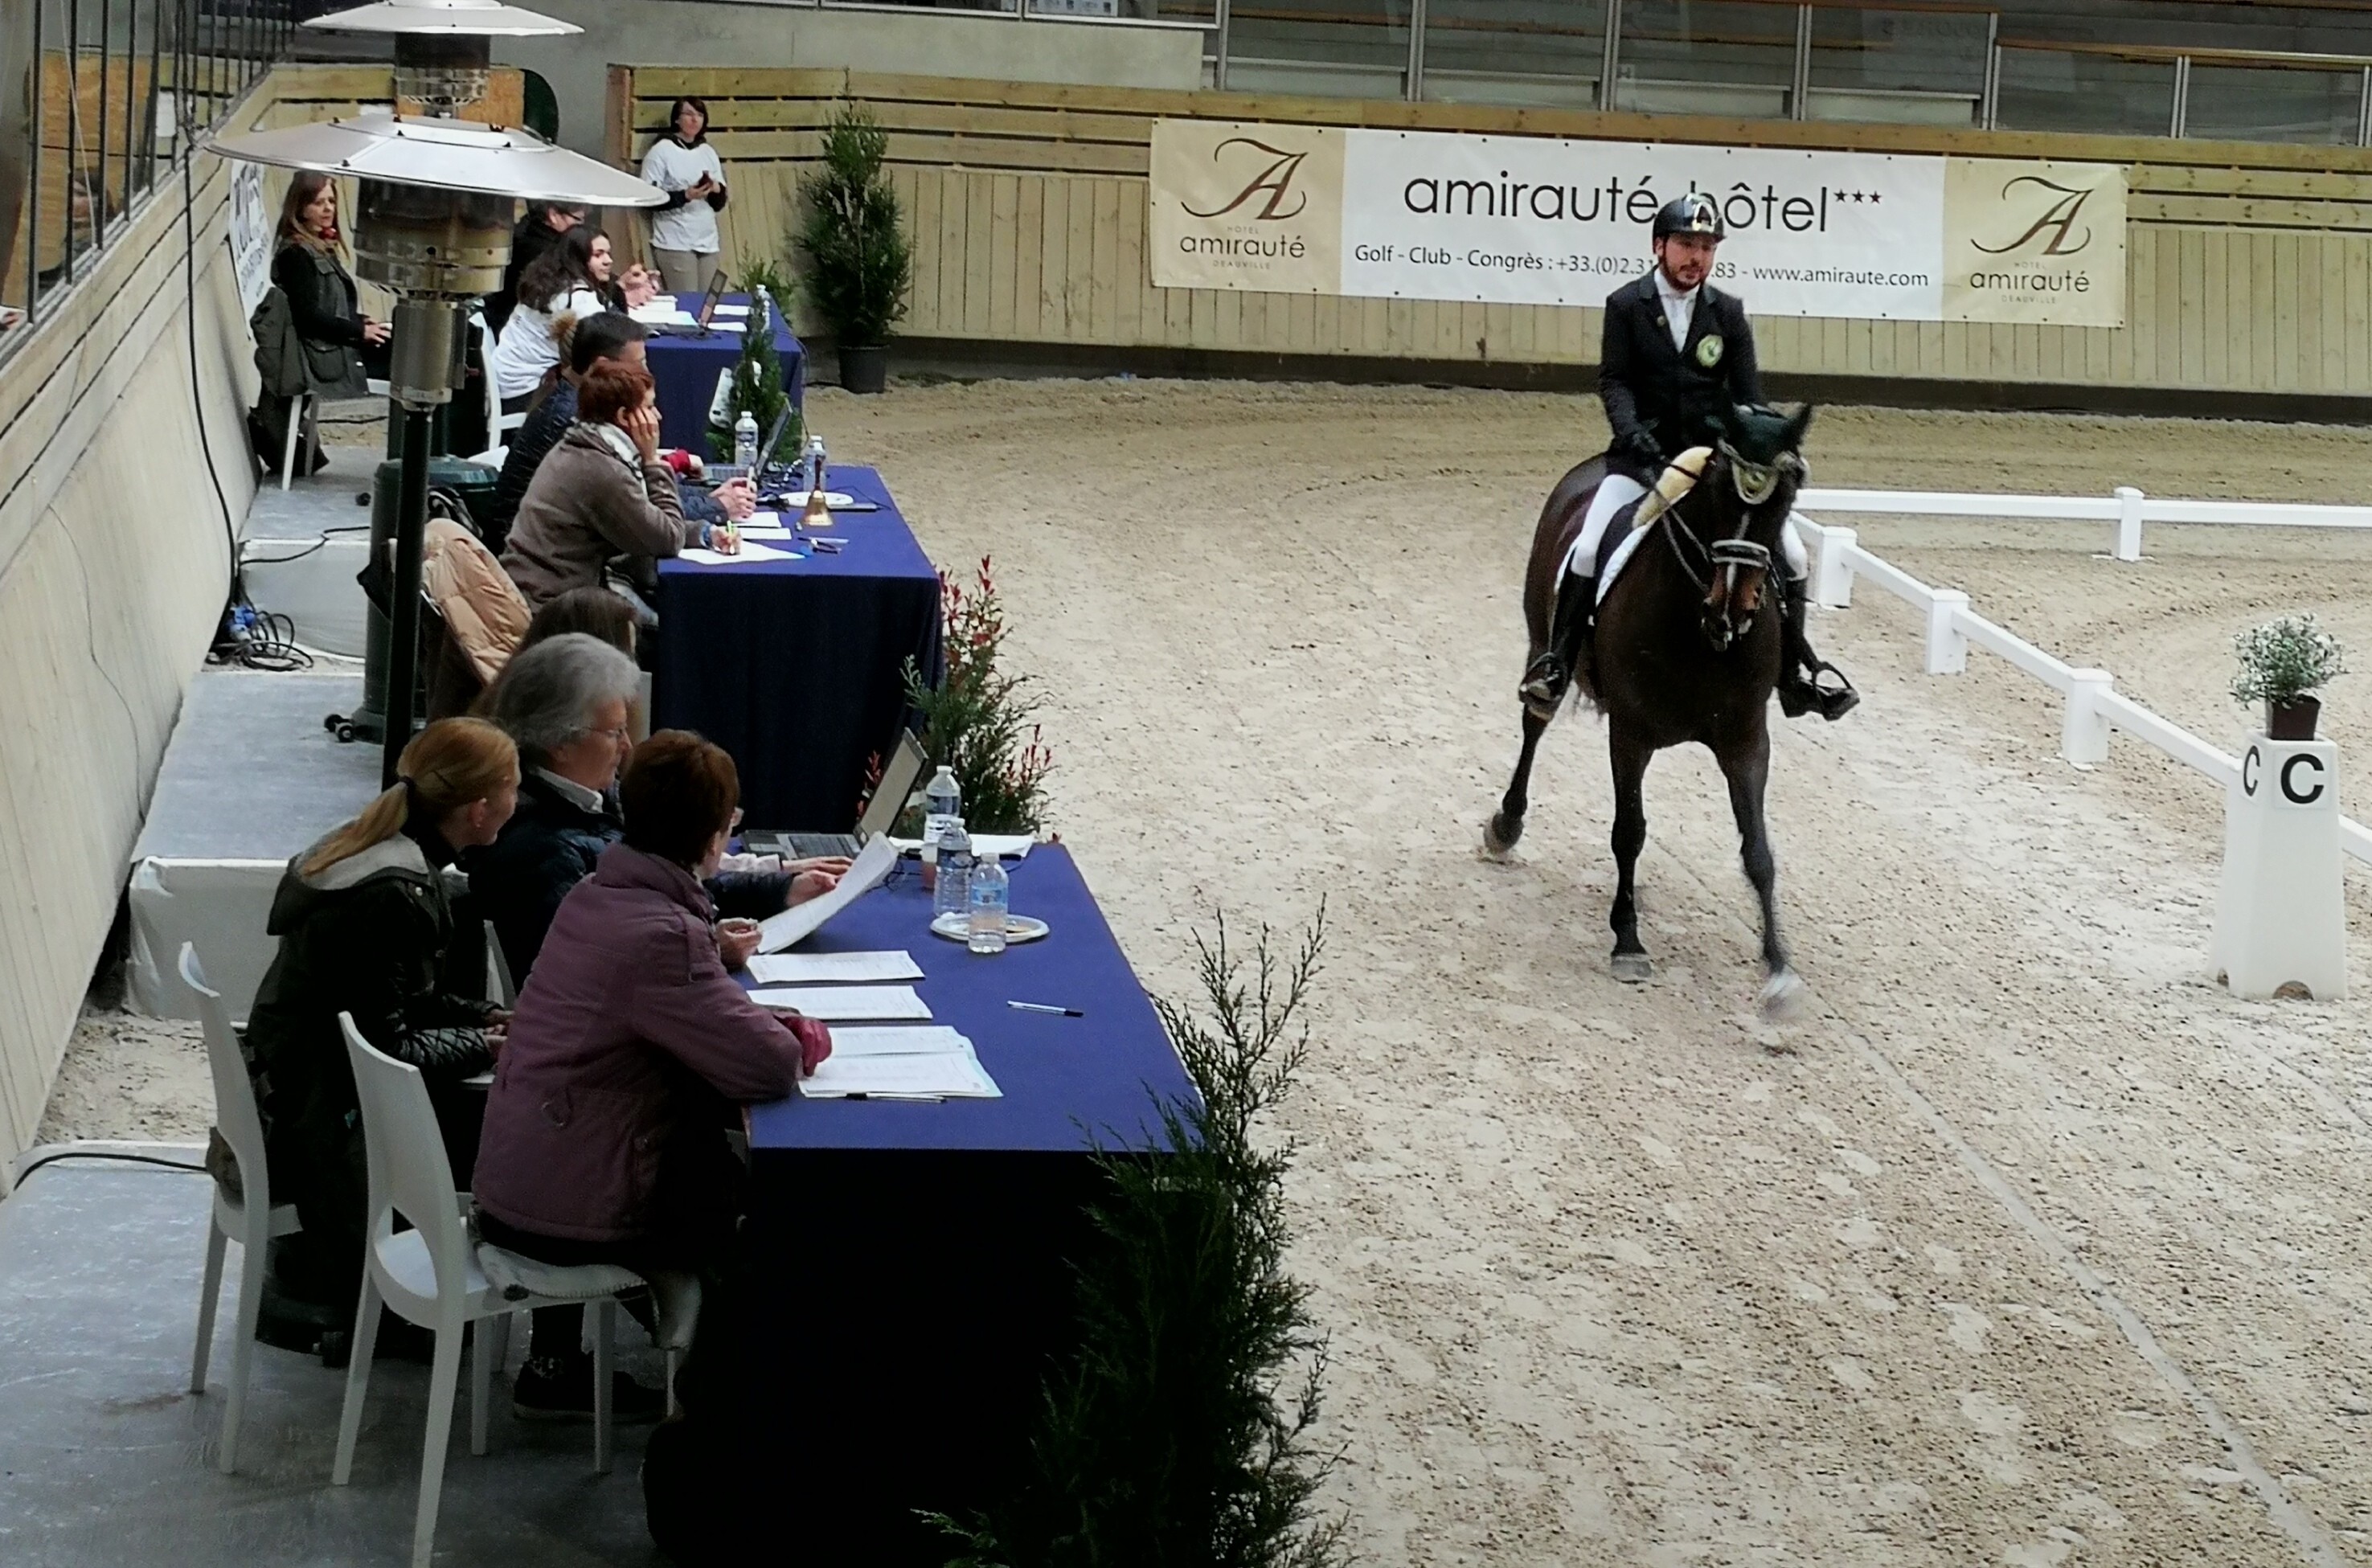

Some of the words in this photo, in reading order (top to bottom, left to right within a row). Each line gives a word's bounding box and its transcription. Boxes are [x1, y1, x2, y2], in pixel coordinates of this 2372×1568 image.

[1404, 170, 1659, 224] amirauté
[1180, 234, 1305, 259] amirauté
[1212, 260, 1271, 270] DEAUVILLE
[1355, 244, 1395, 262] Golf
[1409, 247, 1452, 265] Club
[1468, 249, 1543, 272] Congrès
[1753, 267, 1928, 286] www.amiraute.com
[1970, 270, 2090, 292] amirauté
[2001, 295, 2057, 305] DEAUVILLE
[2243, 745, 2261, 797] C
[2280, 753, 2325, 804] C
